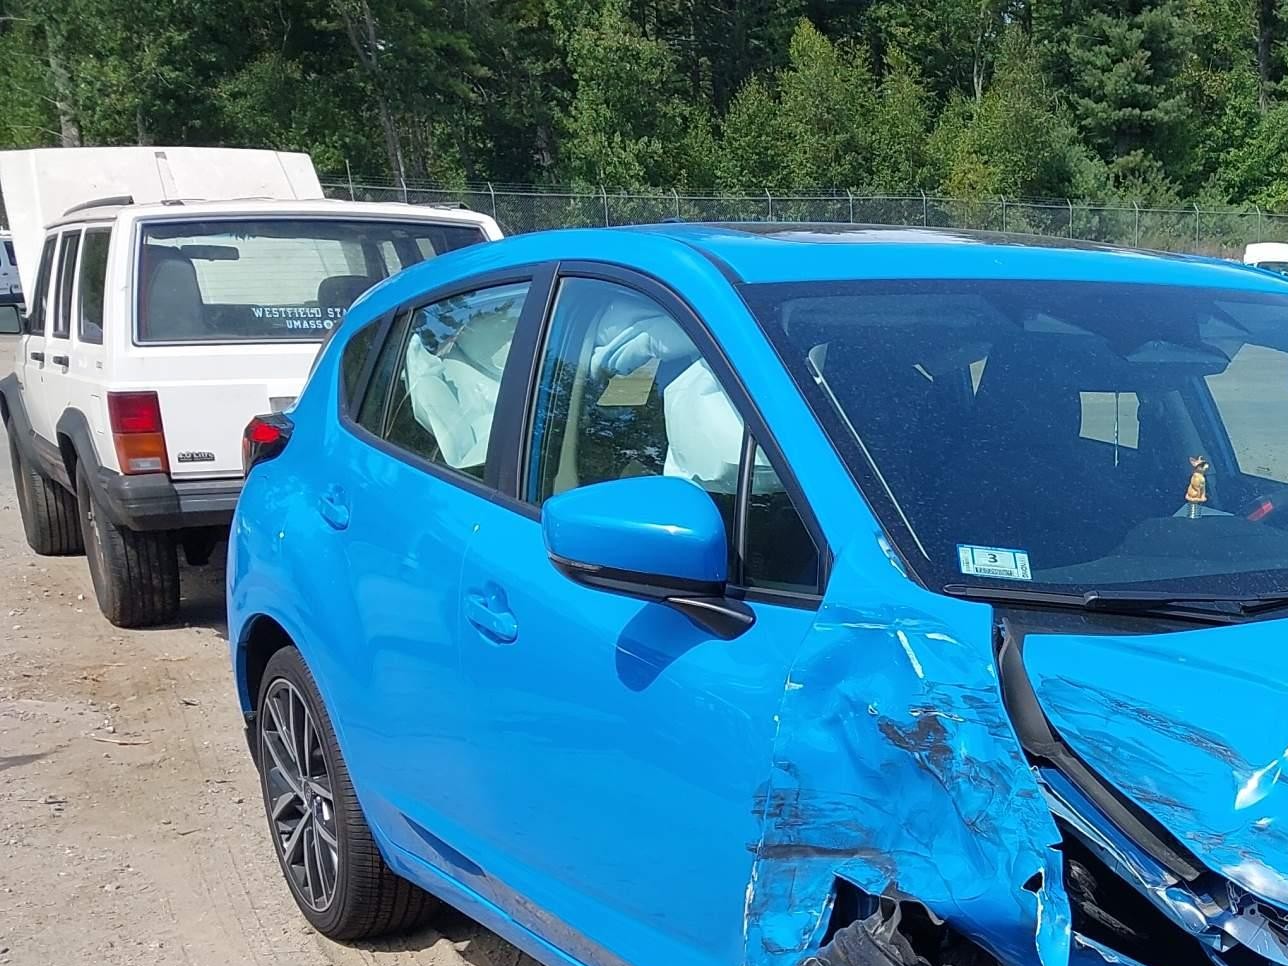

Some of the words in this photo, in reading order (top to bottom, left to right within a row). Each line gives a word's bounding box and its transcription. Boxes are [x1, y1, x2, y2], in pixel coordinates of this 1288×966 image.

[251, 307, 322, 318] WESTFIELD
[286, 320, 323, 329] UMASS
[987, 553, 999, 564] 3
